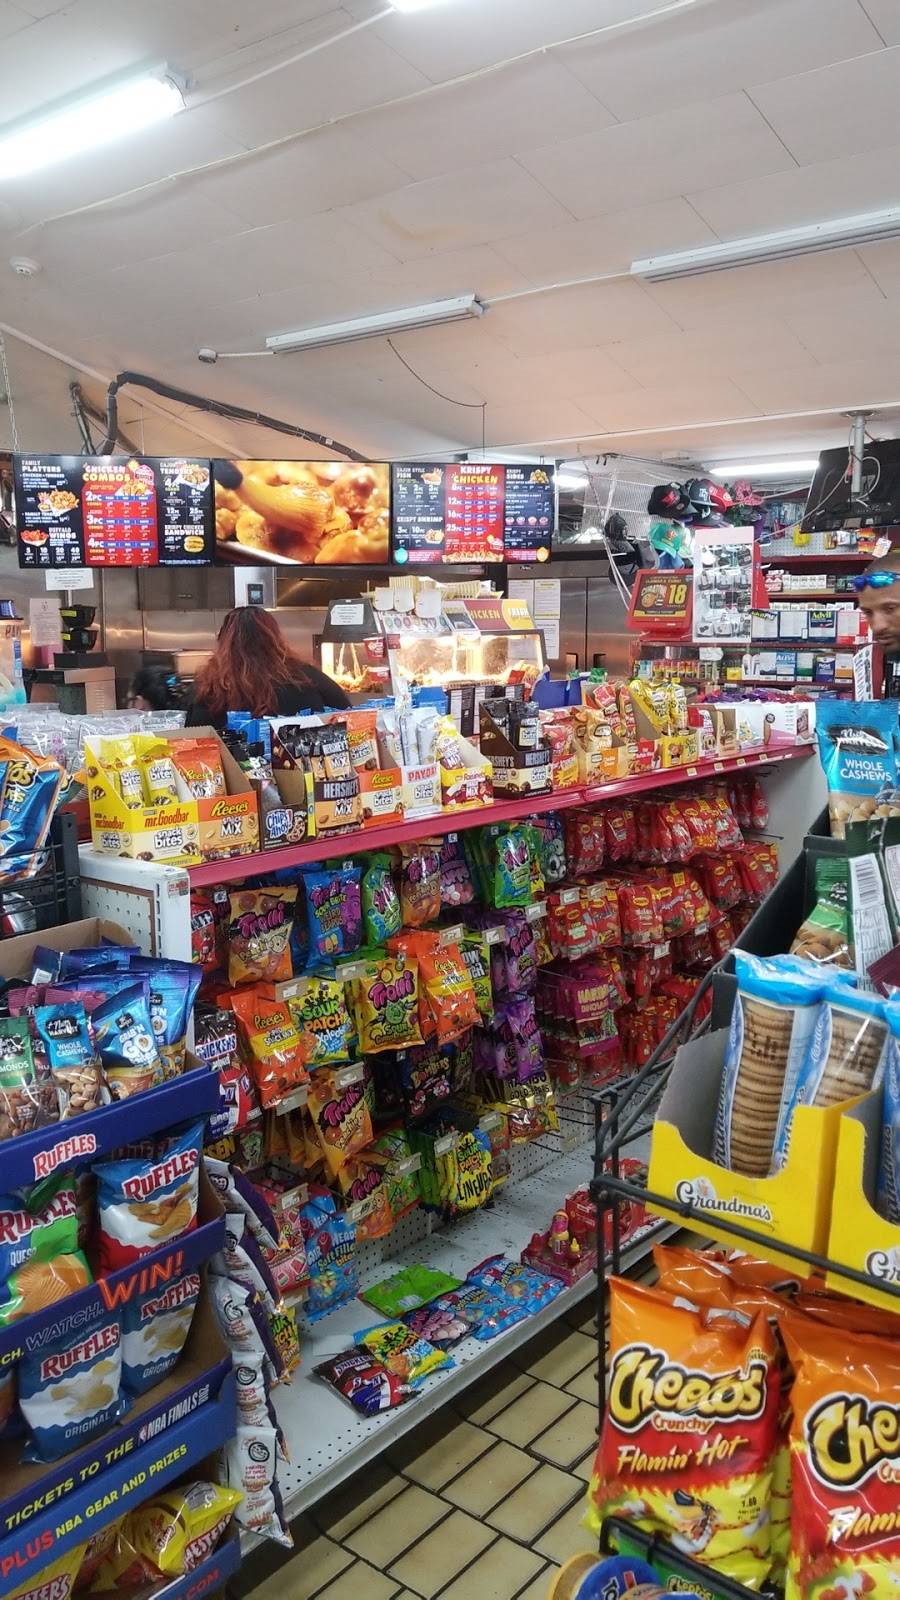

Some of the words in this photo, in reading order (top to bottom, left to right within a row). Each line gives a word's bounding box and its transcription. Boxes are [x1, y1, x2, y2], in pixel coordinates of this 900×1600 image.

[82, 473, 131, 481] COMBOS
[85, 465, 126, 473] CHICKEN
[461, 466, 491, 474] KRISPY
[453, 475, 498, 484] CHICKEN
[85, 491, 102, 501] 2PC
[86, 515, 104, 524] 3PC
[88, 538, 105, 547] 4PC
[668, 584, 688, 605] 18
[469, 609, 501, 619] HICKEN
[812, 611, 833, 619] Advil
[845, 759, 884, 771] WHOLE
[840, 768, 893, 782] CASHEWS
[374, 798, 393, 806] bites
[415, 788, 434, 799] bites
[211, 799, 249, 816] Reese's
[267, 812, 289, 830] Chips
[156, 827, 182, 838] snack
[103, 839, 121, 849] bites
[155, 835, 183, 849] bites
[239, 903, 285, 938] Trolli
[369, 970, 414, 1009] Trolli
[303, 1001, 339, 1019] SOUR
[254, 1012, 284, 1029] Reese's
[304, 1014, 344, 1032] PATCH
[57, 1041, 81, 1050] WHOLE
[57, 1047, 89, 1058] CASHEWS
[123, 1034, 154, 1060] GO
[0, 1061, 29, 1074] MONDS
[323, 1085, 363, 1129] Trolli
[34, 1136, 95, 1180] RUFFLES
[124, 1150, 199, 1200] RUFFLES
[677, 1181, 772, 1221] Grandma's
[0, 1191, 77, 1243] RUFLES
[866, 1252, 900, 1283] Gr
[26, 1302, 103, 1351] WATCH.
[98, 1250, 184, 1312] WIN!
[141, 1273, 200, 1323] RUFFLES
[40, 1322, 120, 1383] RUFFLES
[334, 1354, 376, 1377] SNICKERS
[65, 1411, 110, 1438] ORIGINAL
[652, 1412, 714, 1434] Crunchy
[805, 1394, 900, 1490] Che
[5, 1478, 75, 1531] TICKETS
[79, 1460, 101, 1480] TO
[105, 1437, 134, 1465] THE
[147, 1416, 168, 1439] NBA
[167, 1391, 200, 1425] FINALS
[617, 1445, 693, 1472] Flamin'
[696, 1433, 748, 1467] Hot
[877, 1459, 900, 1483] Cru
[2, 1528, 55, 1577] PLUS
[55, 1515, 83, 1539] NBA
[85, 1490, 119, 1518] GEAR
[121, 1475, 147, 1500] AND
[148, 1443, 188, 1477] PRIZES
[828, 1506, 900, 1542] Flami
